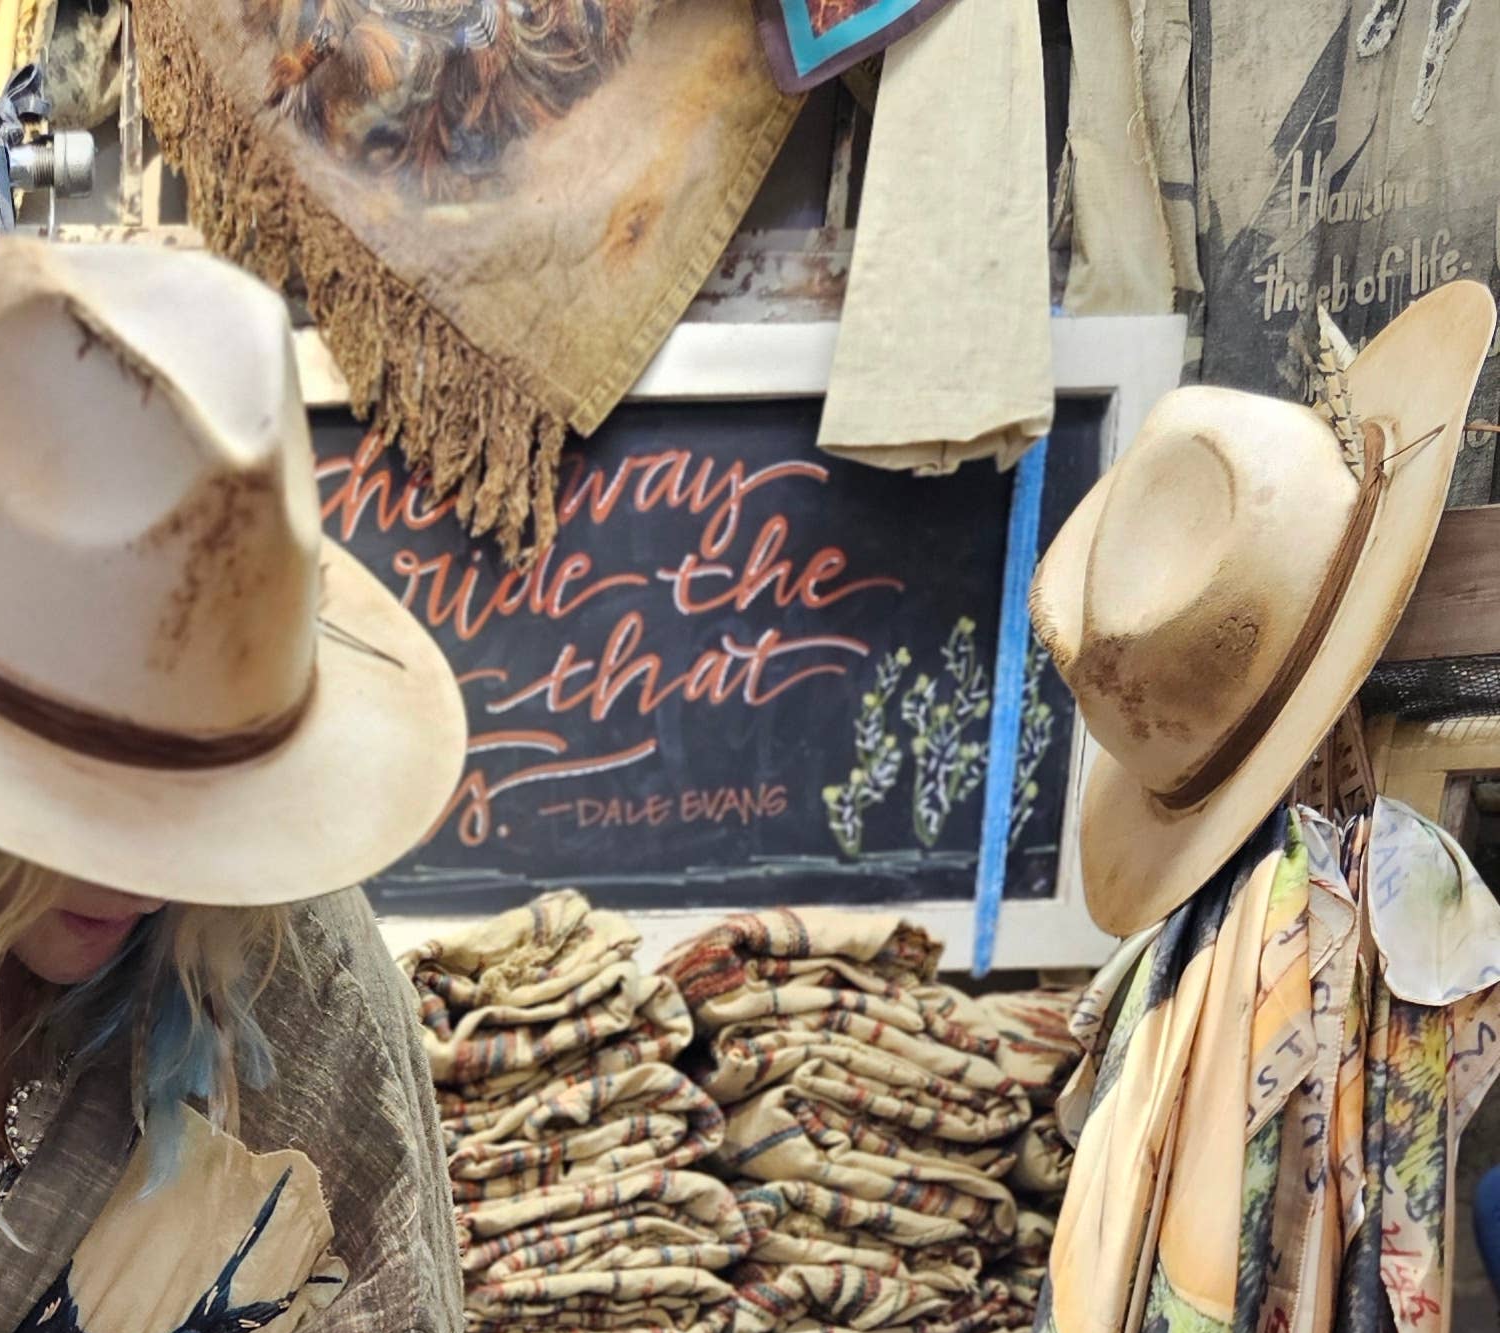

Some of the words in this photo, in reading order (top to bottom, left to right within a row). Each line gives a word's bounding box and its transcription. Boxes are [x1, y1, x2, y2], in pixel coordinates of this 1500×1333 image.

[1254, 252, 1310, 322] the
[1355, 246, 1405, 306] of
[1410, 228, 1472, 296] life.
[558, 448, 830, 560] way
[656, 514, 905, 615] the
[486, 610, 870, 721] that
[680, 783, 789, 826] EVANS
